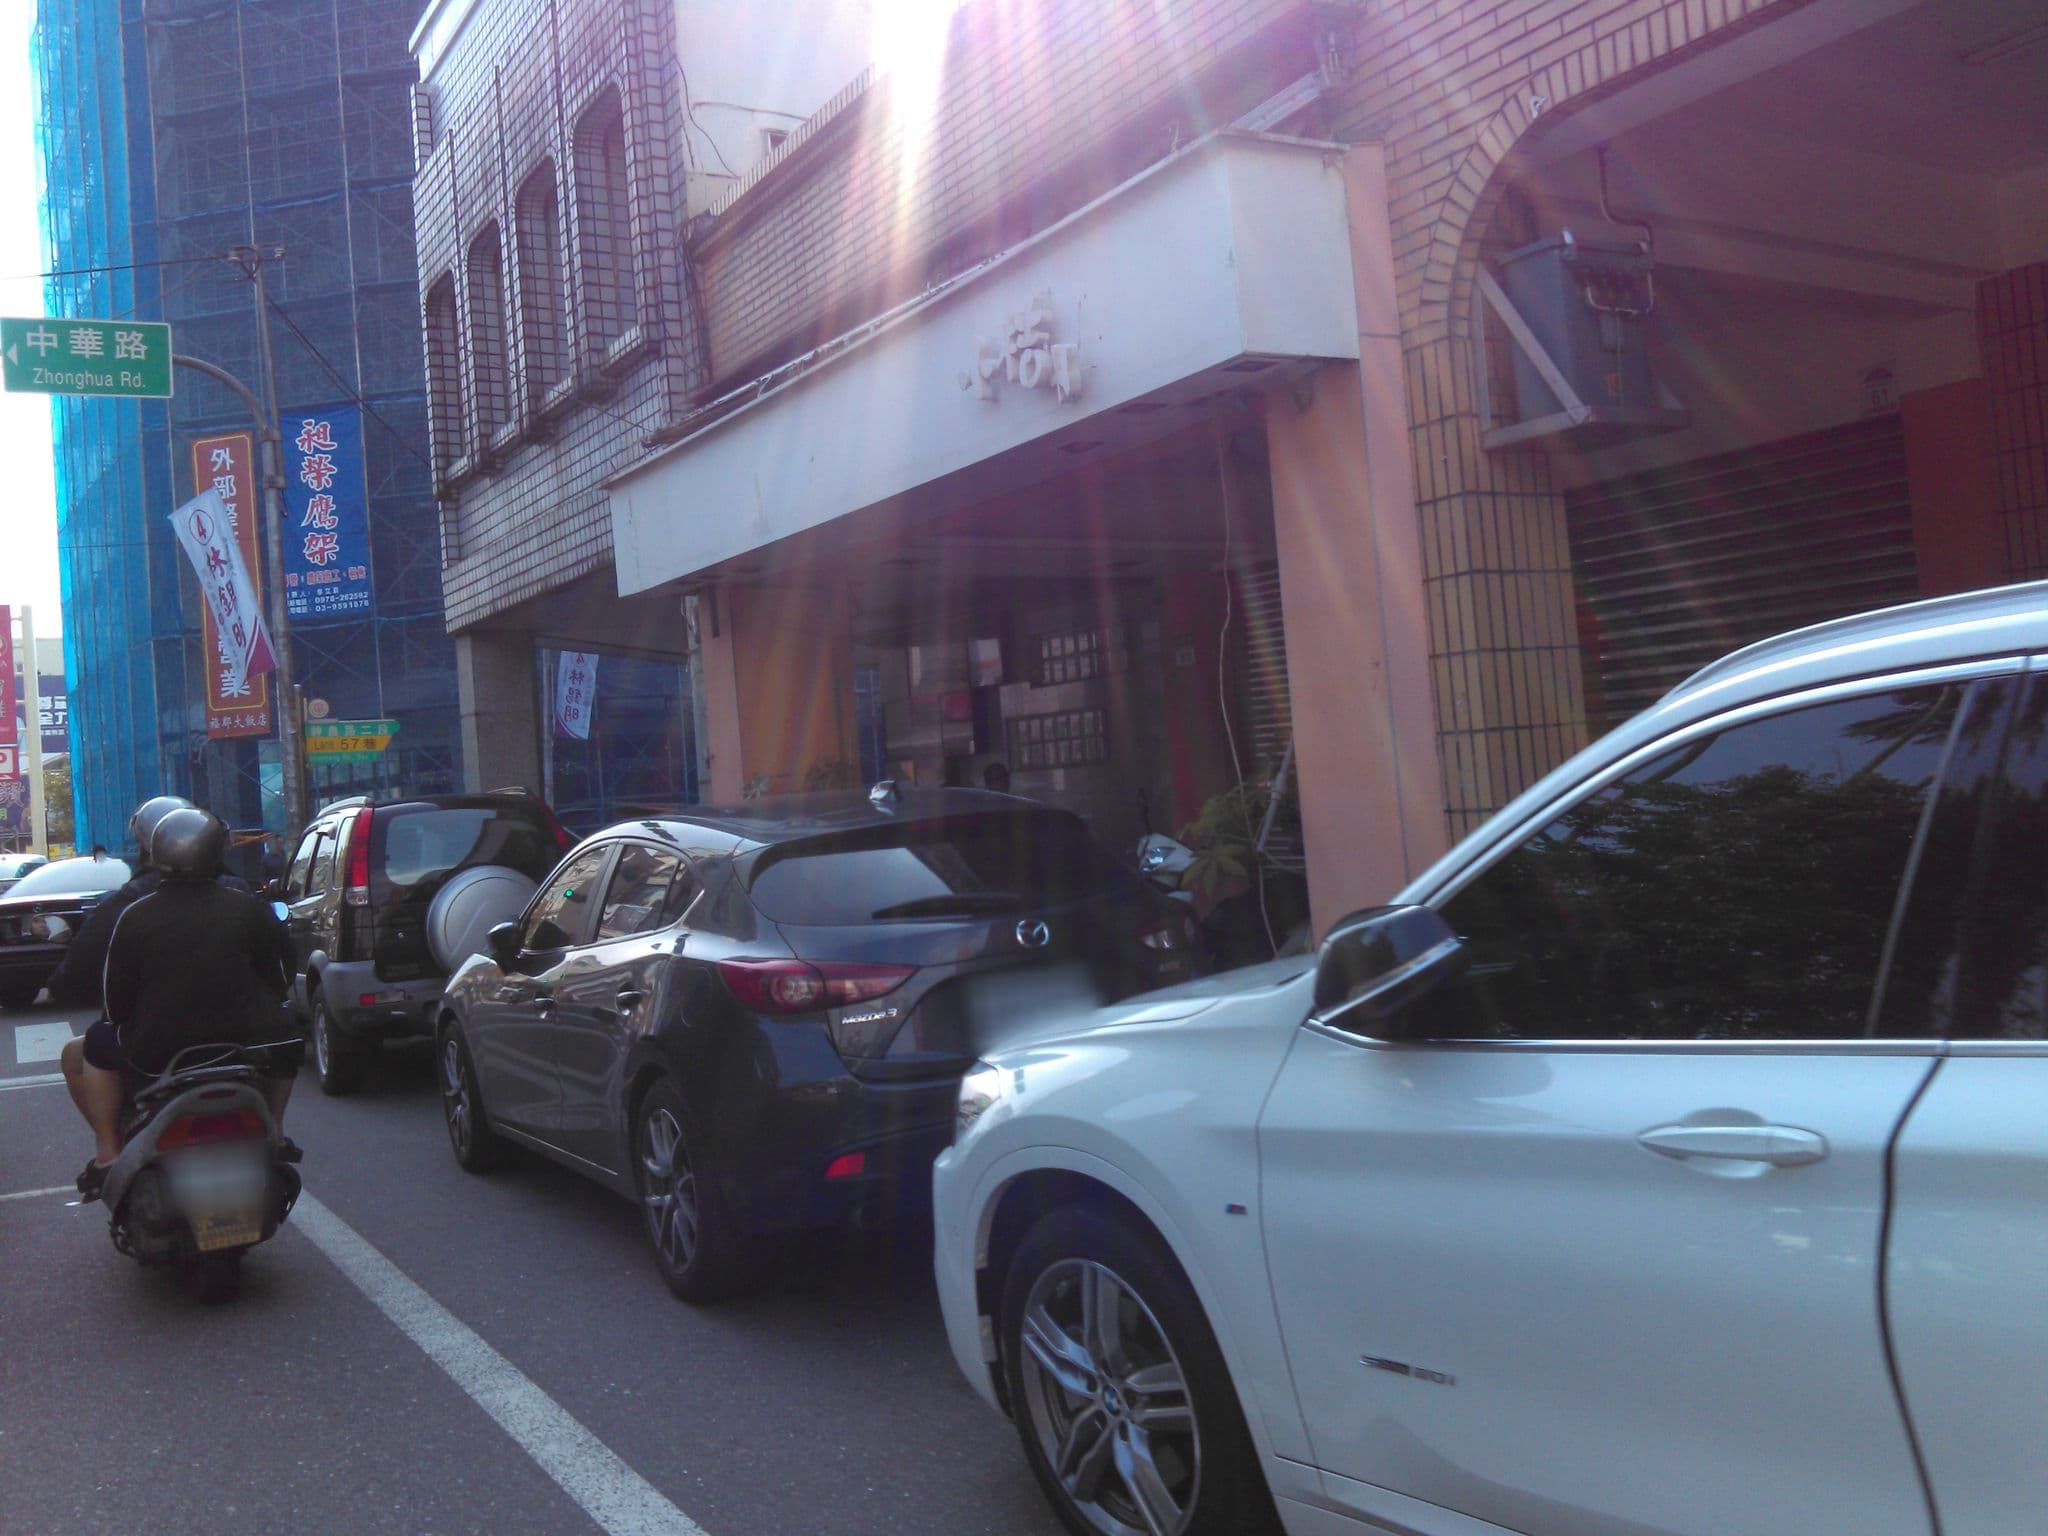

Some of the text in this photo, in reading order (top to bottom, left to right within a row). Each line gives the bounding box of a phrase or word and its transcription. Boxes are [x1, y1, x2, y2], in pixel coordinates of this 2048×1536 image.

[26, 324, 148, 361] 中華路
[32, 367, 146, 389] Zhonghua Rd.
[296, 418, 340, 566] 昶榮鷹架
